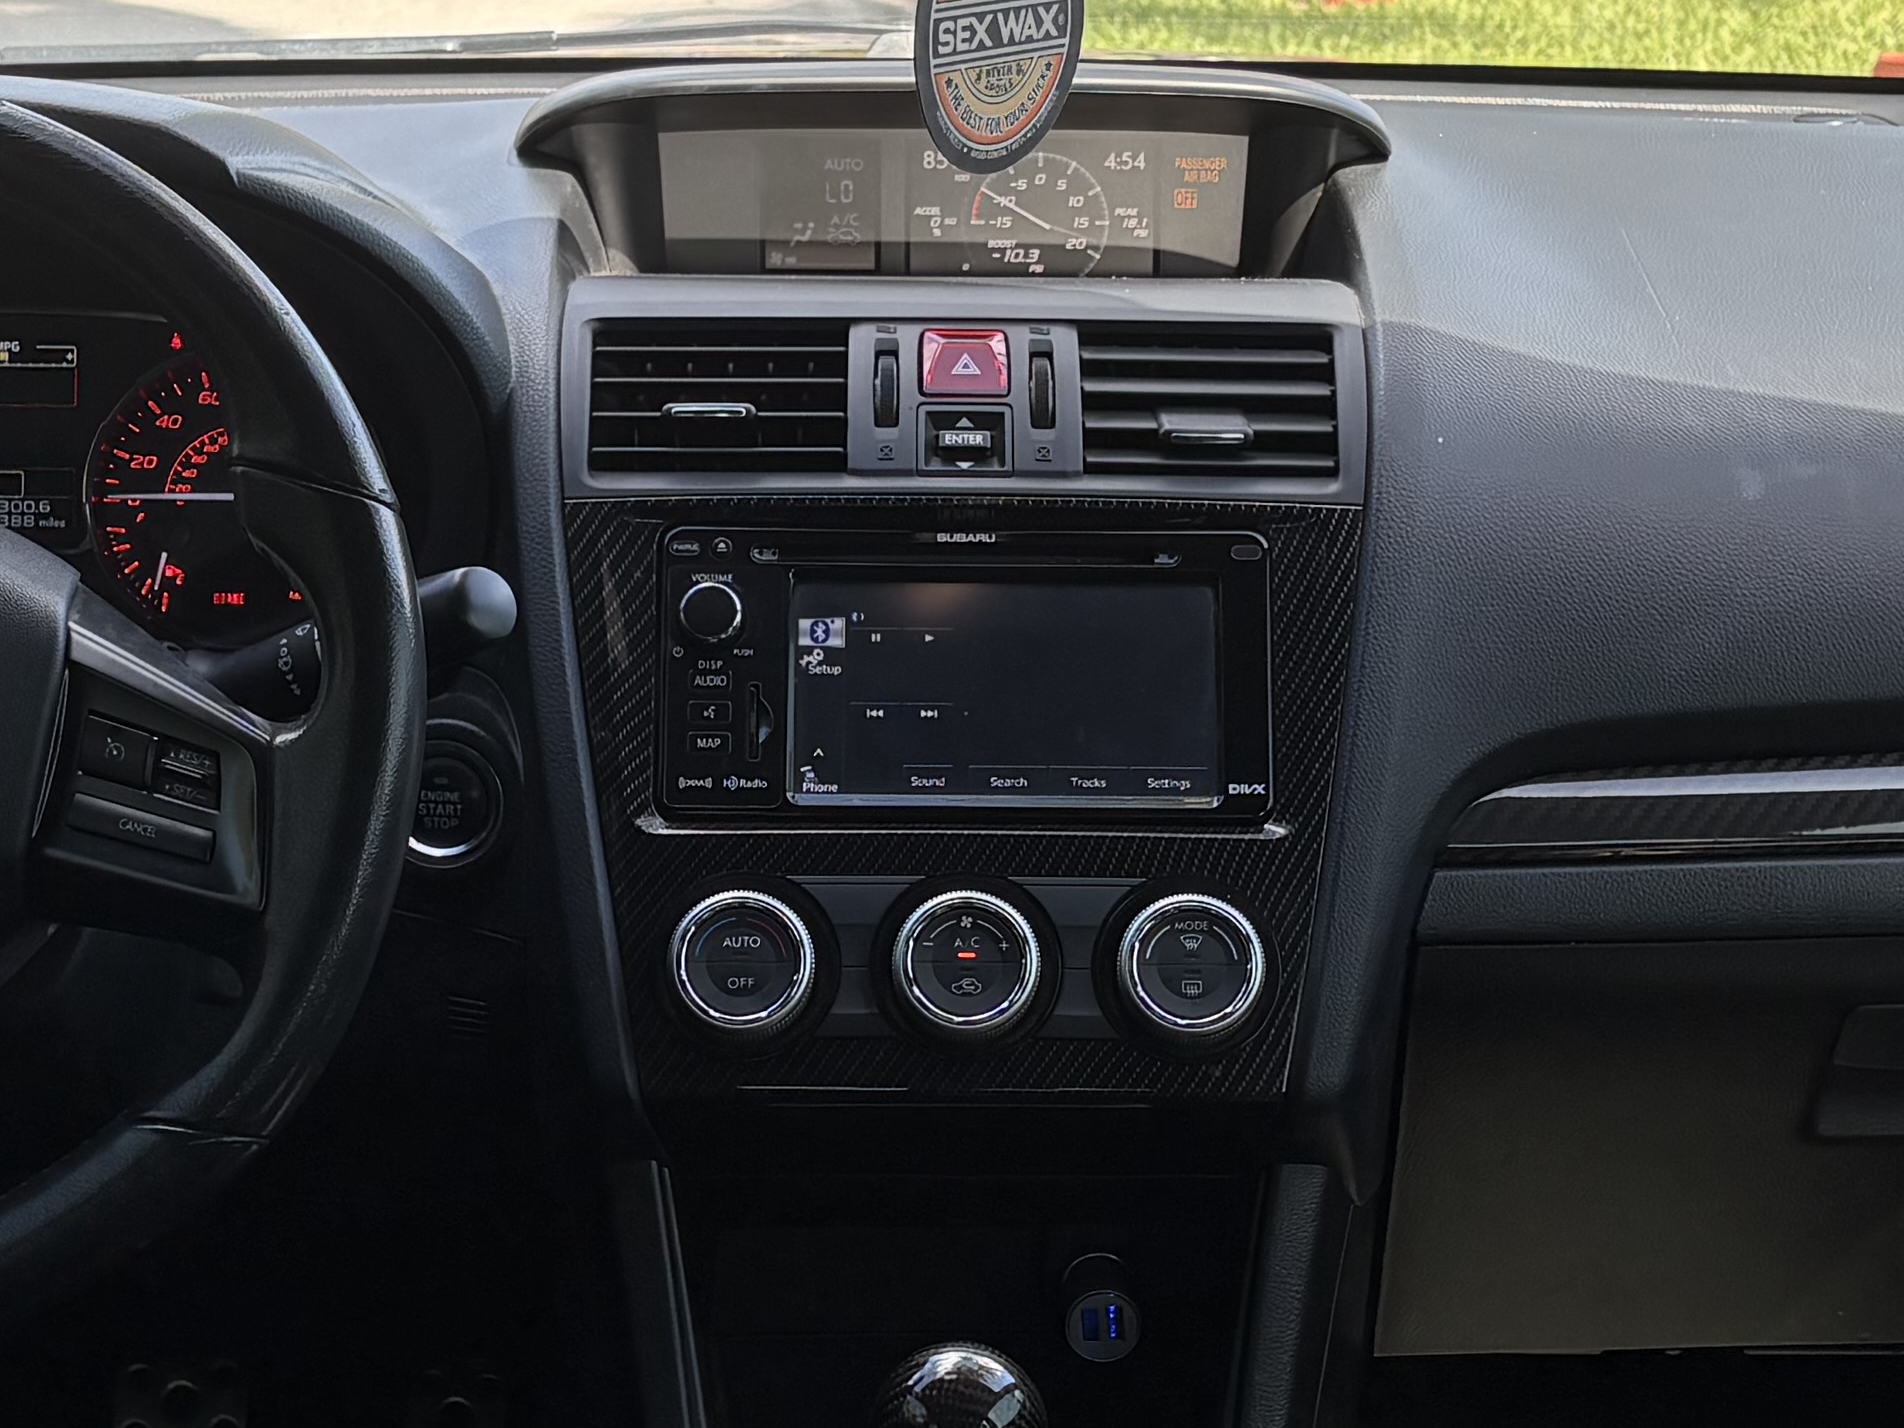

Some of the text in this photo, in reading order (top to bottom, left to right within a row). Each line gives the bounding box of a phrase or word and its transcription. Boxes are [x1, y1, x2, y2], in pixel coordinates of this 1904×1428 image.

[937, 3, 1061, 55] SEX WAX
[824, 158, 864, 172] AUTO
[1104, 152, 1146, 170] 4:54
[1175, 157, 1228, 170] PASSENGER
[1010, 180, 1028, 191] -5
[1034, 174, 1047, 185] 0
[1056, 179, 1068, 191] 5
[1068, 195, 1085, 208] 10
[1175, 190, 1198, 207] OFF
[913, 207, 942, 217] ACCEL
[1114, 207, 1139, 218] PEAK
[930, 217, 941, 228] 0
[989, 217, 1013, 229] -15
[1072, 217, 1090, 229] 15
[1122, 218, 1149, 229] 18.1
[1133, 228, 1150, 238] PSI
[987, 239, 1018, 249] BOOST
[1065, 238, 1087, 250] 20
[992, 248, 1041, 264] -10.3
[1028, 263, 1045, 274] PSI
[155, 414, 183, 430] 40
[944, 433, 984, 445] ENTER
[130, 455, 159, 469] 20
[39, 517, 66, 528] miles
[936, 533, 996, 543] SUBARU
[691, 573, 734, 583] VOLUME
[698, 659, 724, 670] DISP
[808, 663, 842, 676] Setup
[693, 674, 727, 687] AUDIO
[696, 737, 722, 749] MAP
[739, 778, 768, 788] Radio
[802, 782, 839, 793] Phone
[910, 776, 946, 788] Sound
[989, 776, 1029, 789] Search
[1070, 776, 1107, 789] Tracks
[1147, 777, 1192, 792] Settings
[420, 789, 462, 802] ENGINE
[417, 802, 463, 816] START
[118, 818, 156, 839] CANCEL
[423, 816, 460, 829] STOP
[1175, 919, 1209, 932] MODE
[722, 935, 762, 950] AUTO
[953, 936, 981, 950] A/C
[727, 976, 756, 990] OFF
